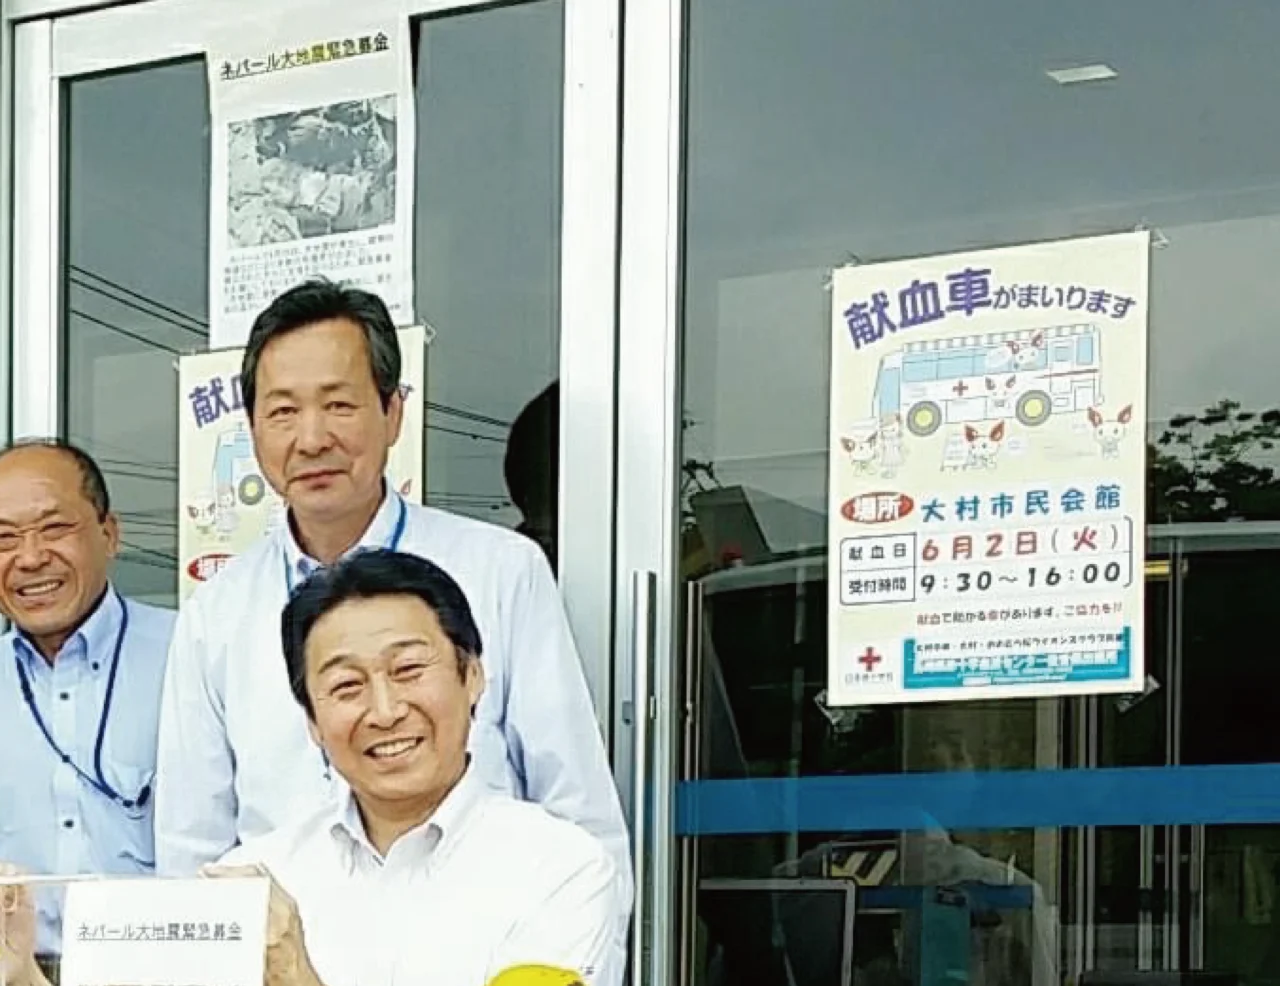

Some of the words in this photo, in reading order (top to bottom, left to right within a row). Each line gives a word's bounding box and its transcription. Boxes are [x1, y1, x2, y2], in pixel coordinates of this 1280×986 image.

[842, 266, 1137, 350] 献血車がまいります
[920, 484, 1122, 523] 大村市民会館
